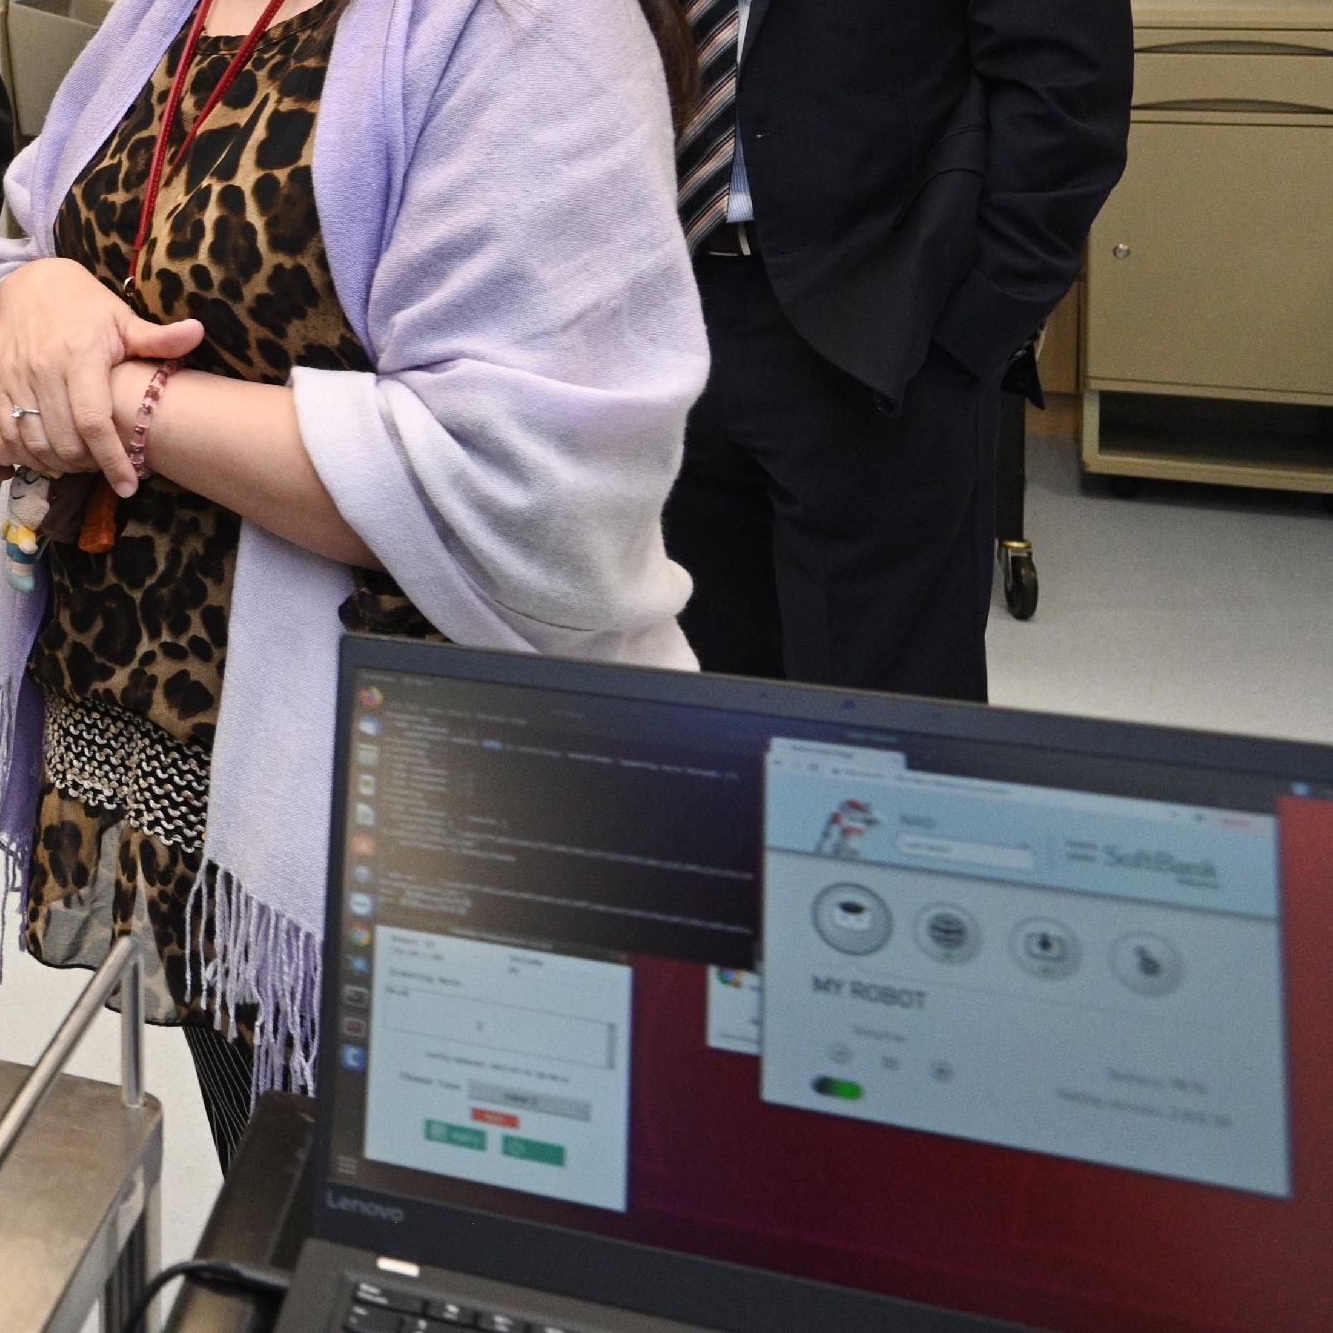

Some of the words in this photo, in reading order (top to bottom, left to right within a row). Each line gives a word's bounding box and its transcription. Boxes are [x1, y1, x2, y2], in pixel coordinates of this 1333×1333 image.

[1104, 843, 1219, 879] SoftBank
[812, 974, 845, 996] MY
[849, 979, 927, 1010] ROBOT
[327, 1190, 405, 1223] Lenovo
